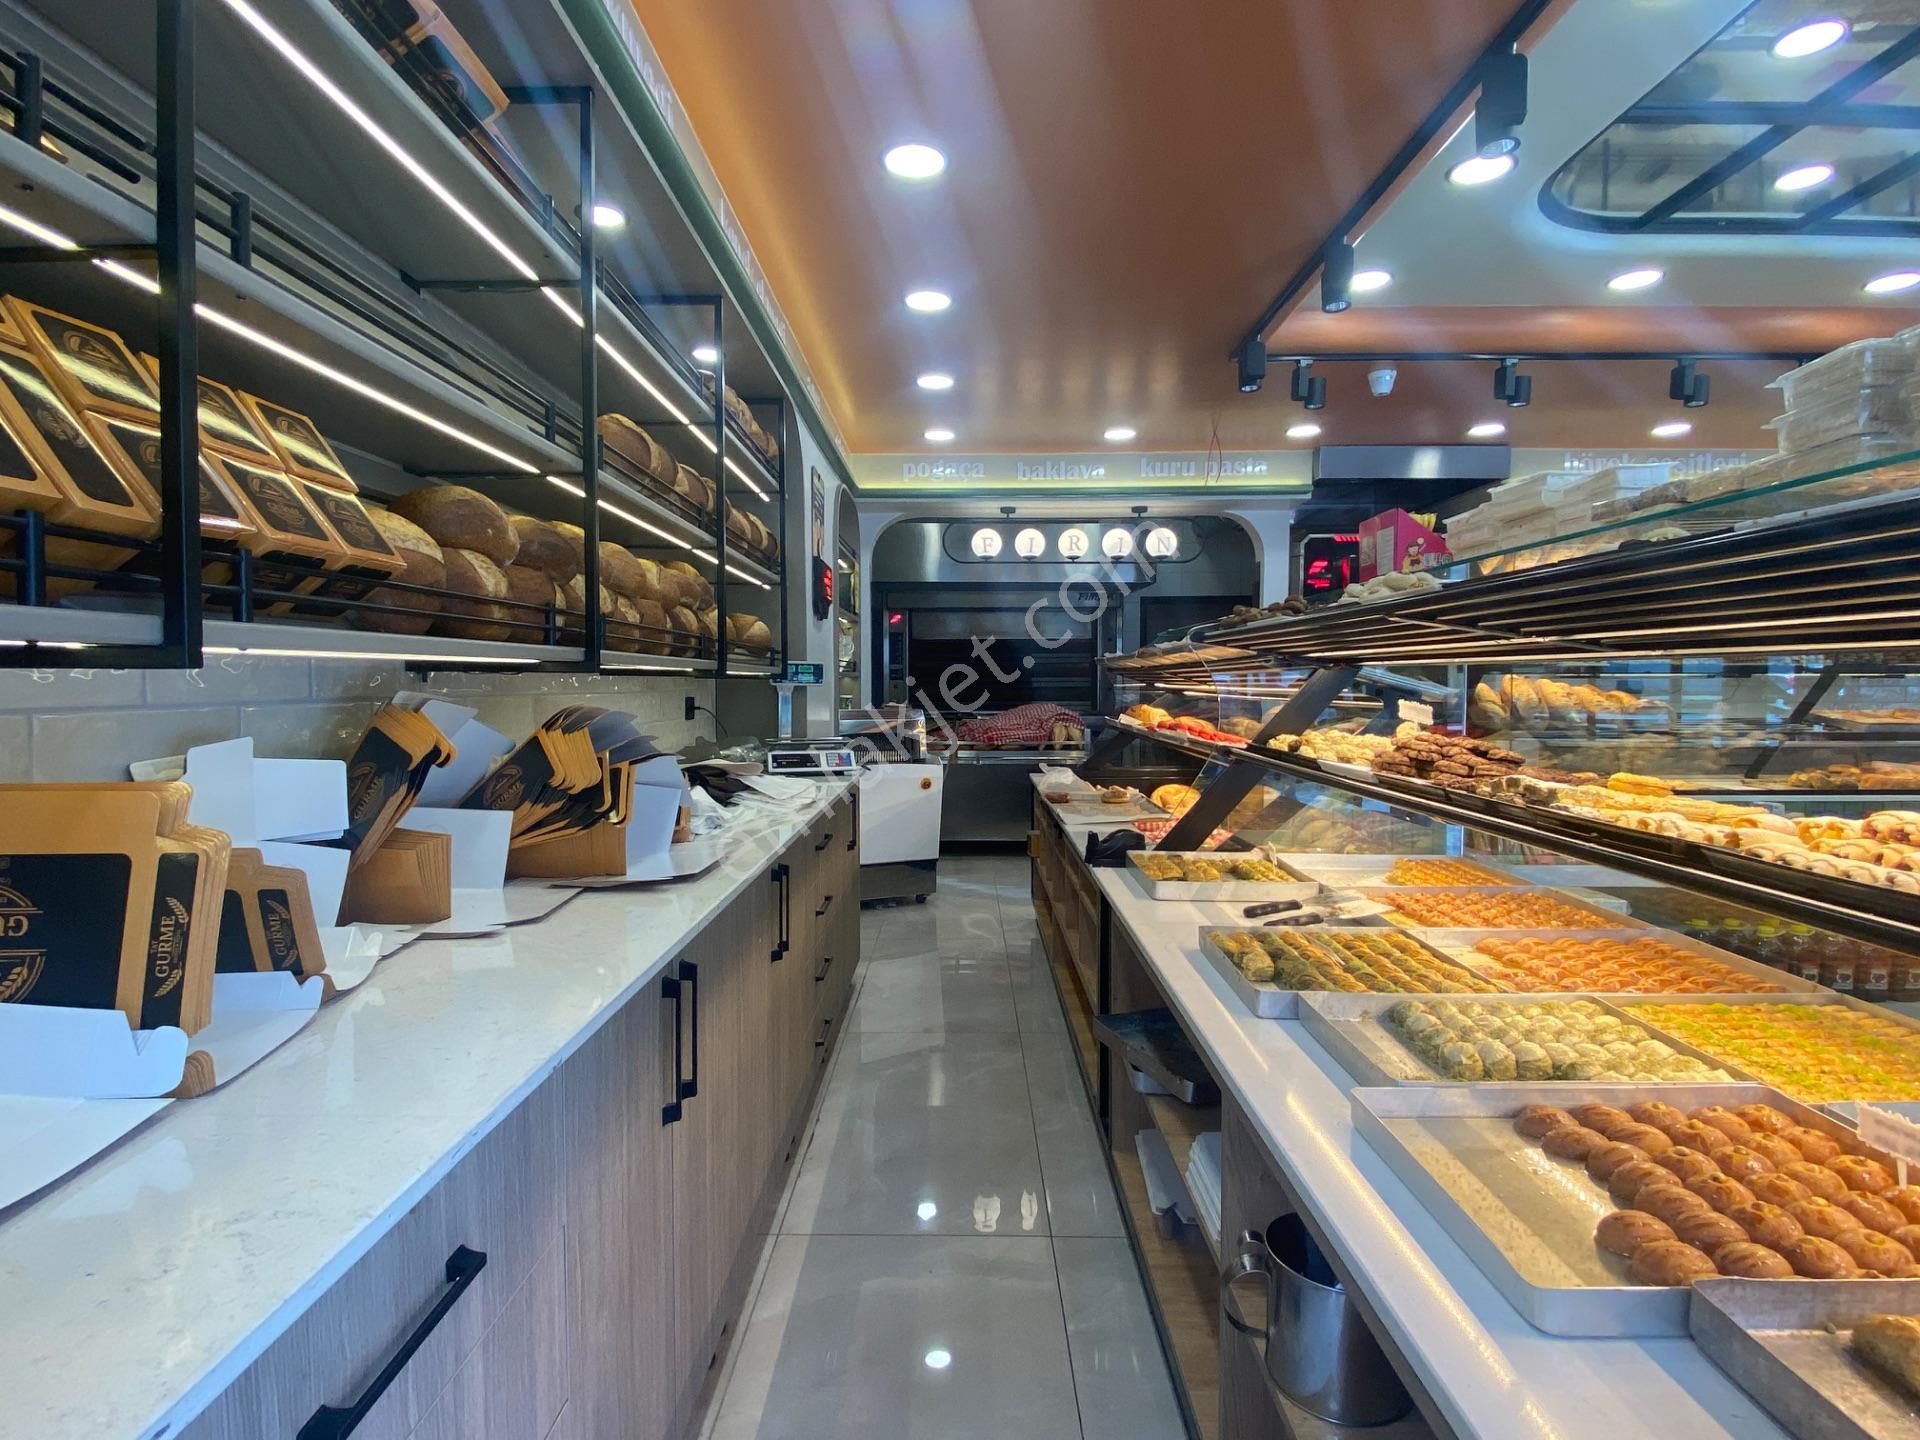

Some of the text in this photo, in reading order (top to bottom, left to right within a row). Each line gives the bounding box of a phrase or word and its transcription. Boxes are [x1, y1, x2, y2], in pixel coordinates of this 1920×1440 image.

[902, 460, 984, 482] poğaça
[1017, 460, 1106, 480] baklava
[1140, 457, 1268, 481] kuru pasta
[268, 912, 288, 956] GURME
[155, 915, 176, 978] GURME
